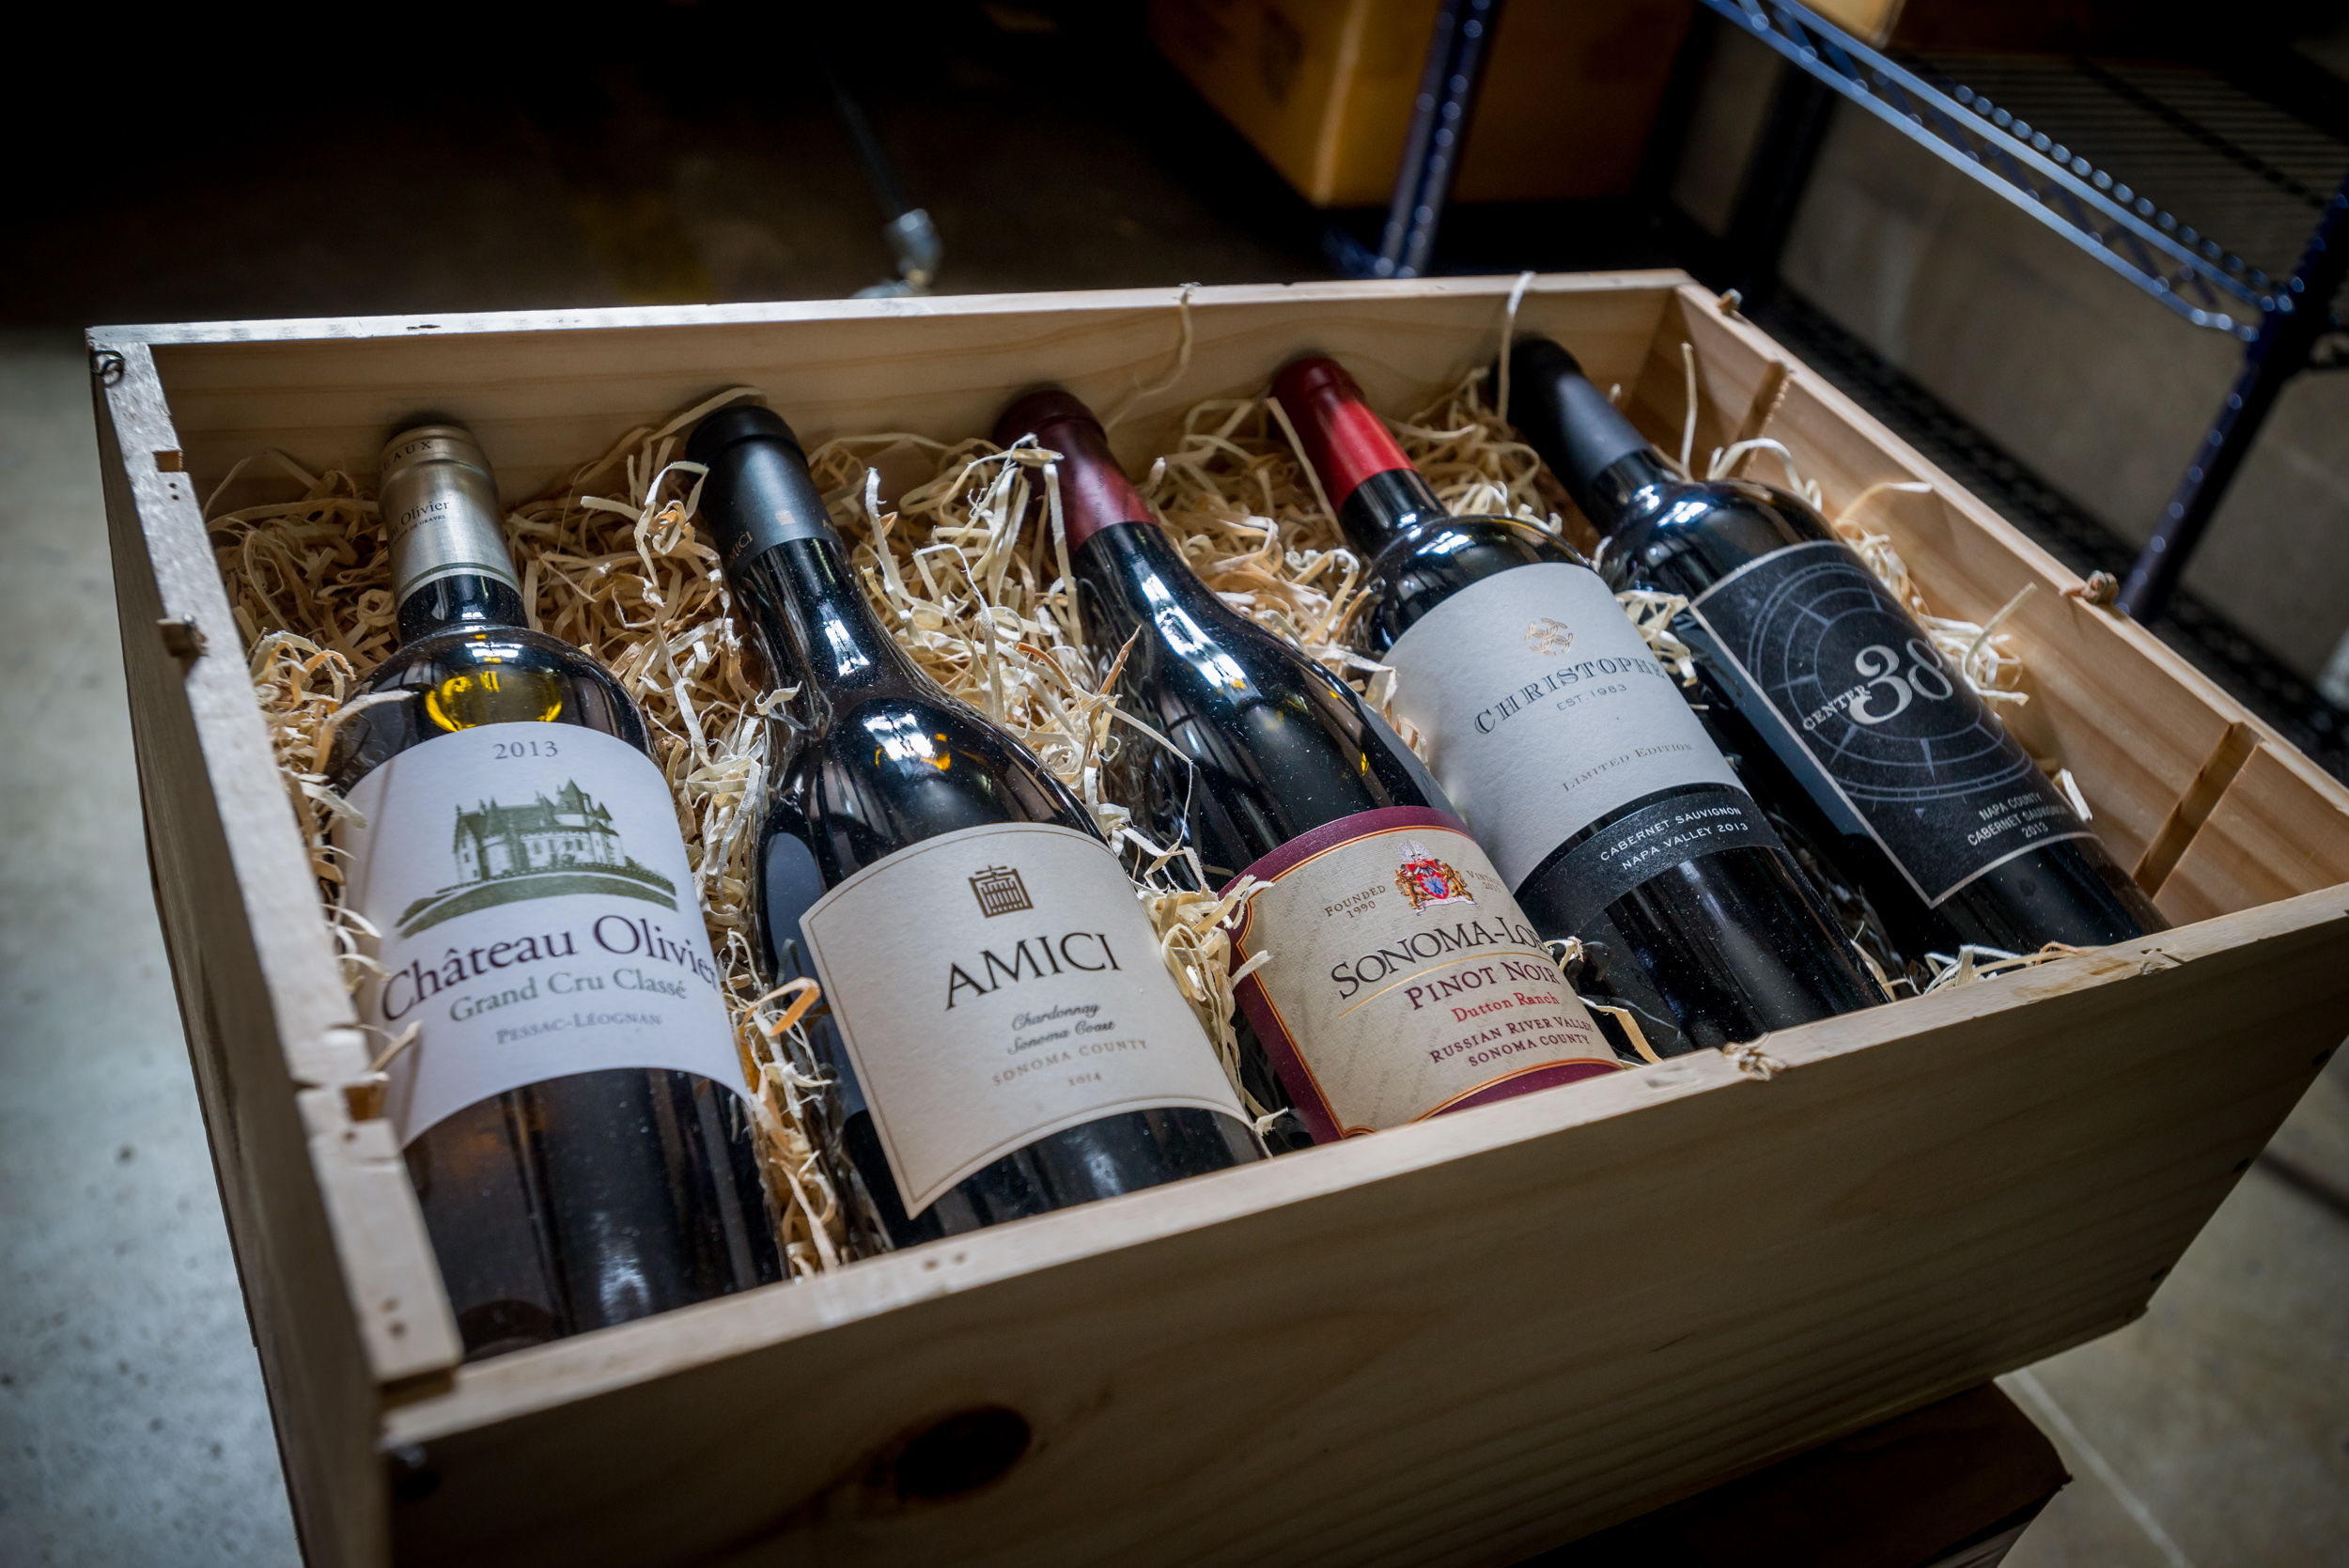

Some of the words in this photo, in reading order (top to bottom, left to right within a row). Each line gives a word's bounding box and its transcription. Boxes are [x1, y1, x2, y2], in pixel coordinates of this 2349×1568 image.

[378, 441, 432, 480] EAUX
[401, 501, 450, 525] Olivier
[420, 515, 445, 525] GRAVES
[728, 531, 754, 561] MICI
[1802, 685, 1872, 732] CENTER
[1849, 638, 1954, 725] 38
[493, 740, 558, 760] 2013
[1562, 754, 1630, 792] LIMITED
[1634, 743, 1692, 758] EDITION
[1979, 801, 2009, 821] NAPA
[2007, 792, 2043, 809] COUNTY
[1600, 819, 1670, 862] CABERNET
[1675, 806, 1742, 825] SAUVIGNON
[1622, 846, 1660, 870] NAPA
[1663, 826, 1713, 847] VALLEY
[1717, 822, 1749, 833] 2013
[1968, 814, 2022, 846] CABERNET
[2021, 821, 2049, 839] 2013
[1325, 884, 1387, 917] FOUNDED
[1346, 900, 1377, 920] 1990
[381, 932, 579, 1021] Château
[944, 932, 1123, 1012] AMICI
[1404, 966, 1498, 1011] PINOT
[1501, 961, 1562, 985] NOIR
[449, 976, 538, 1023] Grand
[547, 970, 604, 996] Cru
[613, 968, 688, 999] Classé
[1451, 999, 1514, 1023] Dutton
[1513, 991, 1560, 1006] Ranch
[1011, 1004, 1101, 1031] Chardonnay
[1006, 1029, 1070, 1055] Sonoma
[1075, 1020, 1115, 1035] Coast
[1429, 1028, 1503, 1063] RUSSIAN
[1505, 1017, 1554, 1034] RIVER
[1552, 1017, 1595, 1032] VALLEY
[1469, 1038, 1538, 1067] SONOMA
[1539, 1033, 1591, 1046] COUNTY
[992, 1050, 1072, 1087] SONOMA
[1078, 1039, 1148, 1057] COUNTY
[1068, 1071, 1102, 1087] 2014
